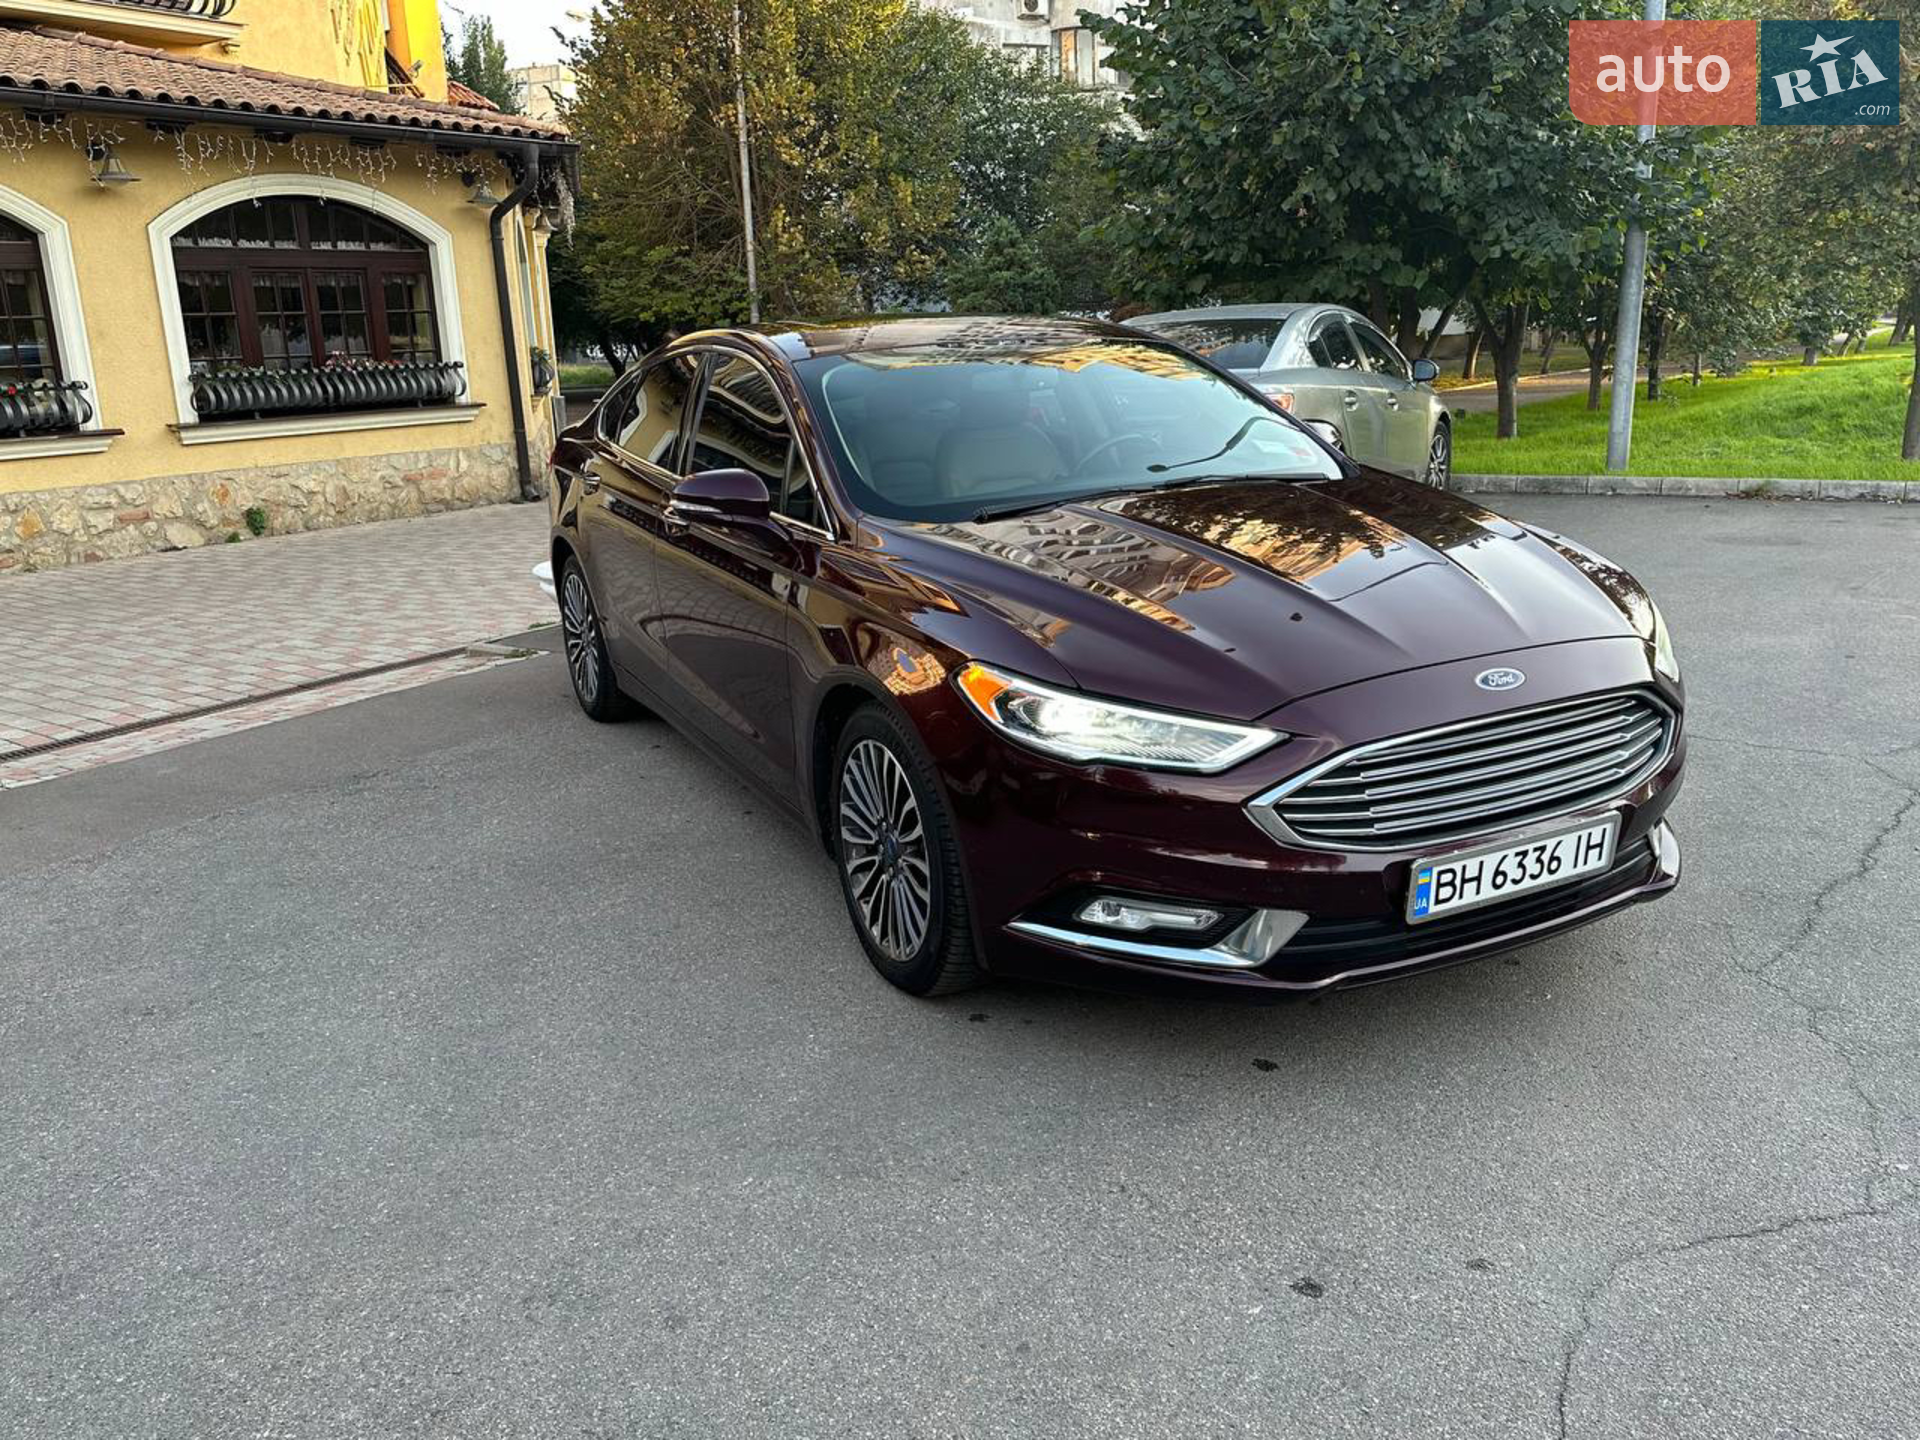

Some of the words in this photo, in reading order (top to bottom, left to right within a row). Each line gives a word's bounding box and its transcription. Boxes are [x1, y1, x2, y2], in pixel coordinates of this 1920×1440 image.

[1434, 860, 1484, 906] BH
[1491, 840, 1563, 890] 6336
[1573, 828, 1607, 869] IH
[1414, 897, 1428, 910] UA
